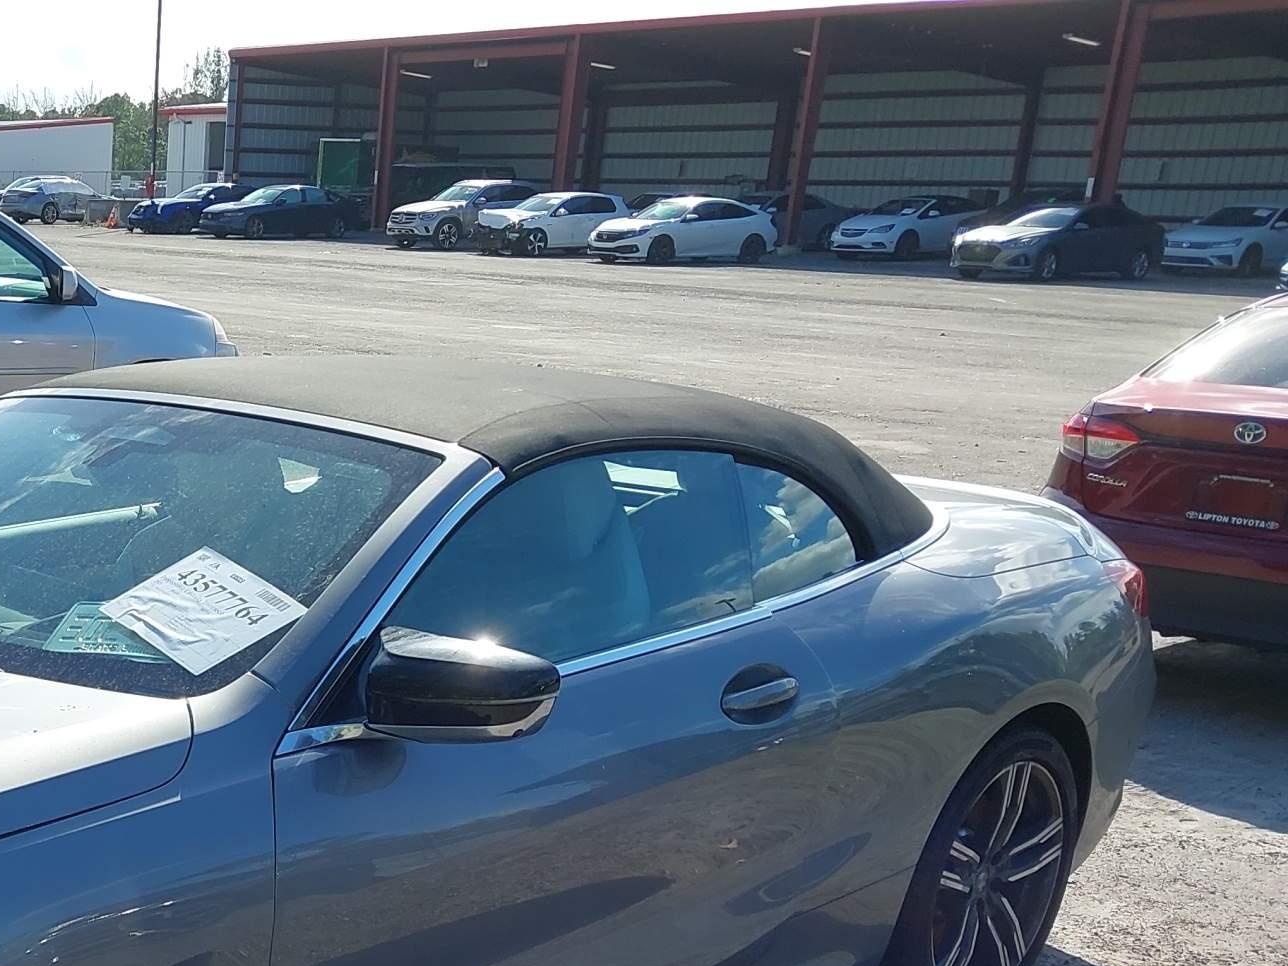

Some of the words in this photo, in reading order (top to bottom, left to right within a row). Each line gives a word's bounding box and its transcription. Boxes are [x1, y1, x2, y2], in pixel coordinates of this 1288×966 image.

[1198, 512, 1229, 524] LIPTON
[1231, 516, 1265, 529] TOYOTA
[176, 569, 270, 626] 43577764
